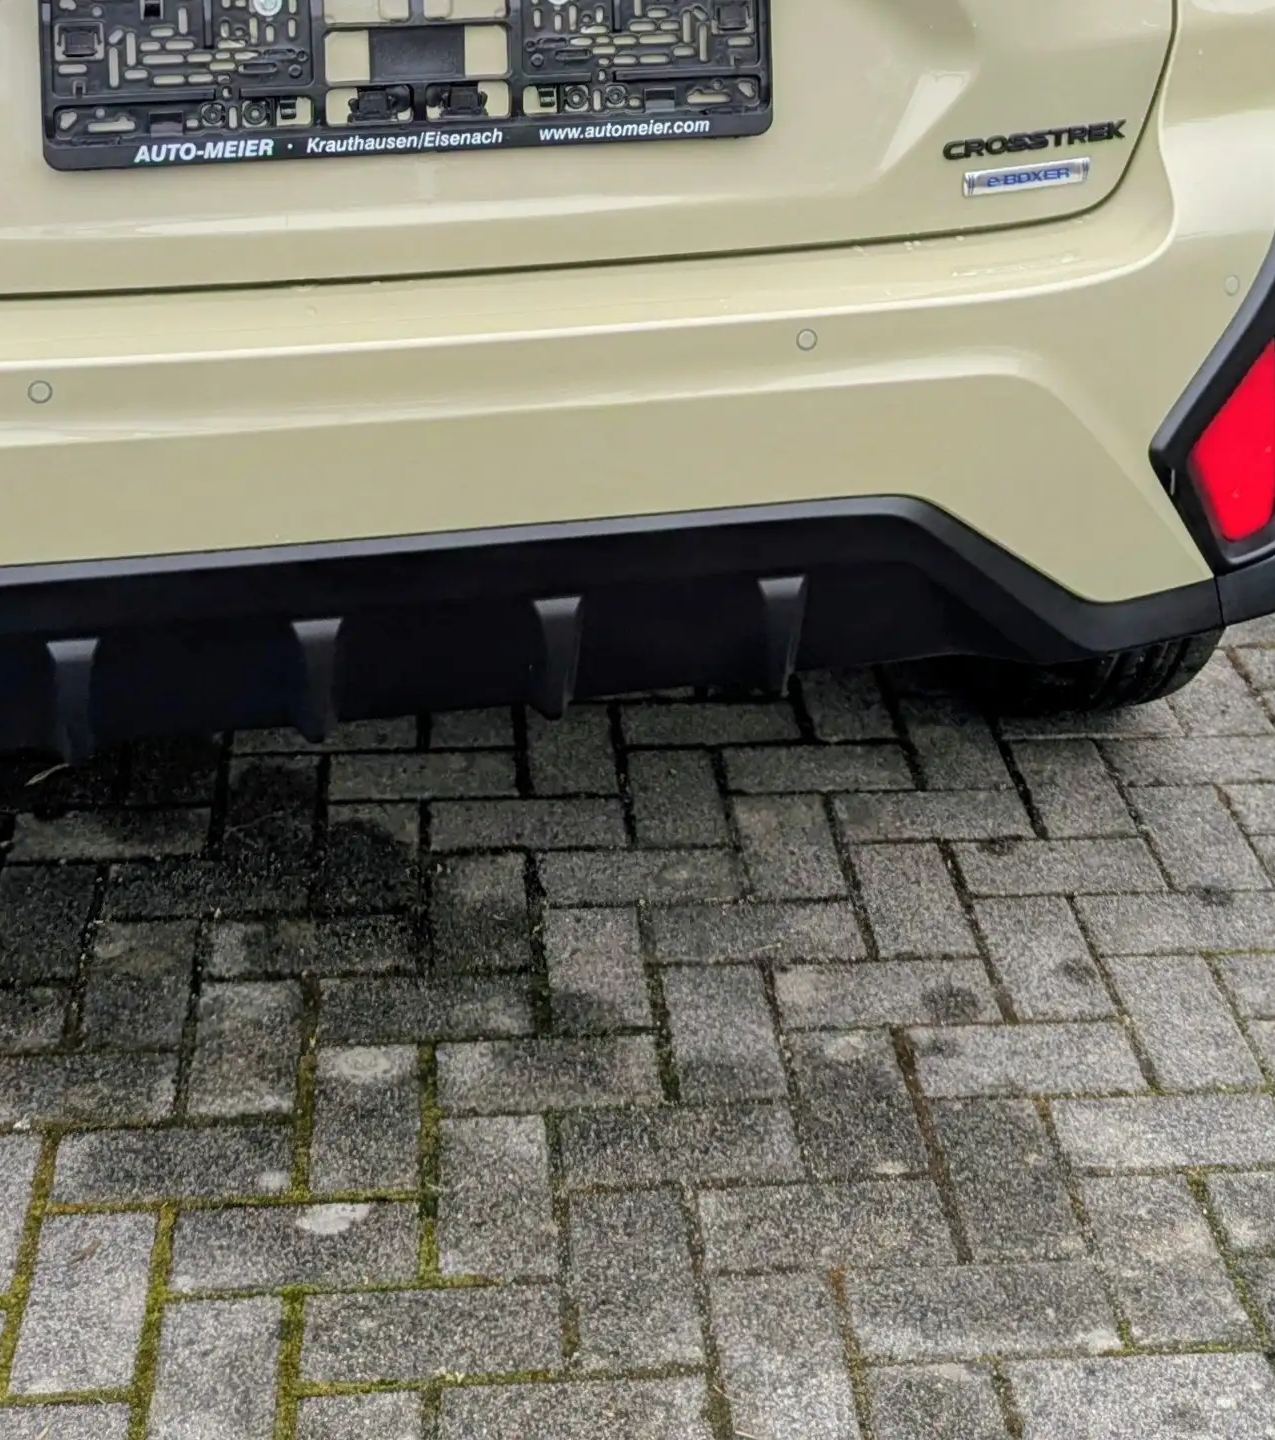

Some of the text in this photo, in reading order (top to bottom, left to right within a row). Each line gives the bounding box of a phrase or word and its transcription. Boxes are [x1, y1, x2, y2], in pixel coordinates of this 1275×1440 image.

[134, 118, 710, 163] AUTO-MEIER Krauthausen/Eisenach www.automeier.com
[942, 118, 1127, 161] CROSSTREK
[986, 166, 1071, 188] e-BOXER
